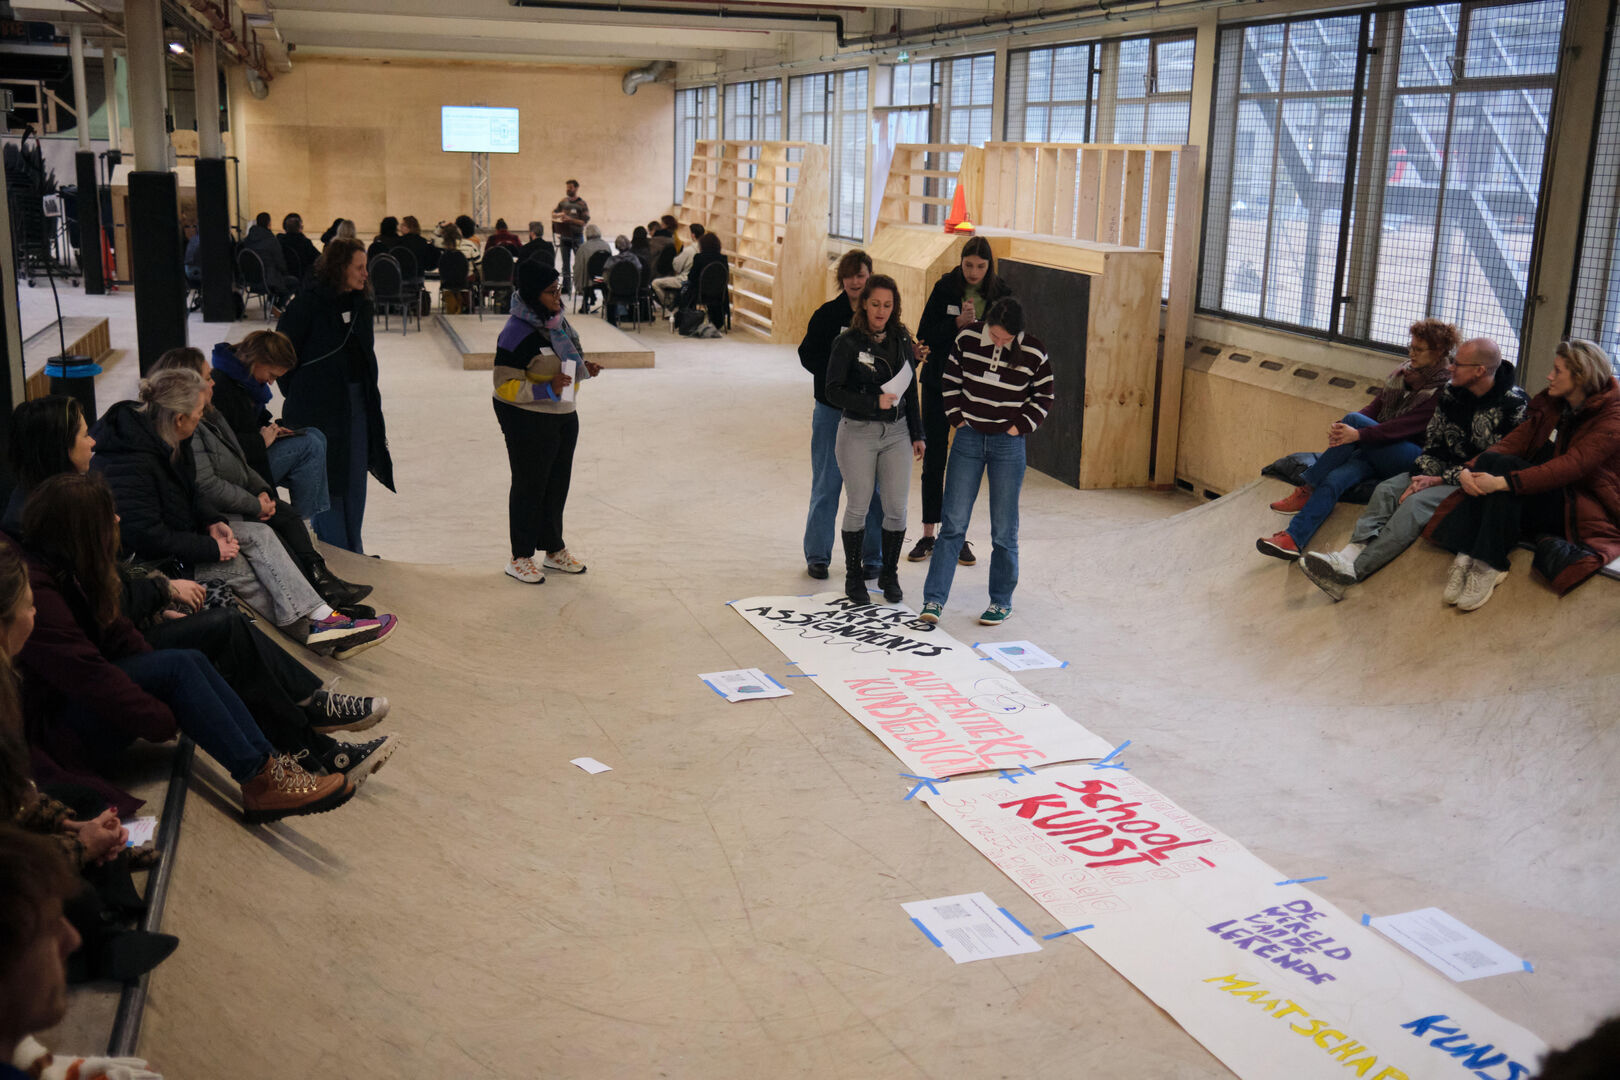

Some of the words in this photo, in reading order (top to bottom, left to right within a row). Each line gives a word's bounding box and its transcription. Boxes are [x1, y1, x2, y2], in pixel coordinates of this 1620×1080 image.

[814, 610, 899, 629] ARTS
[887, 668, 1047, 765] AUTHENTIEKE
[1260, 906, 1352, 961] WERELD
[1282, 899, 1328, 923] DE
[1206, 919, 1337, 985] LERENDE
